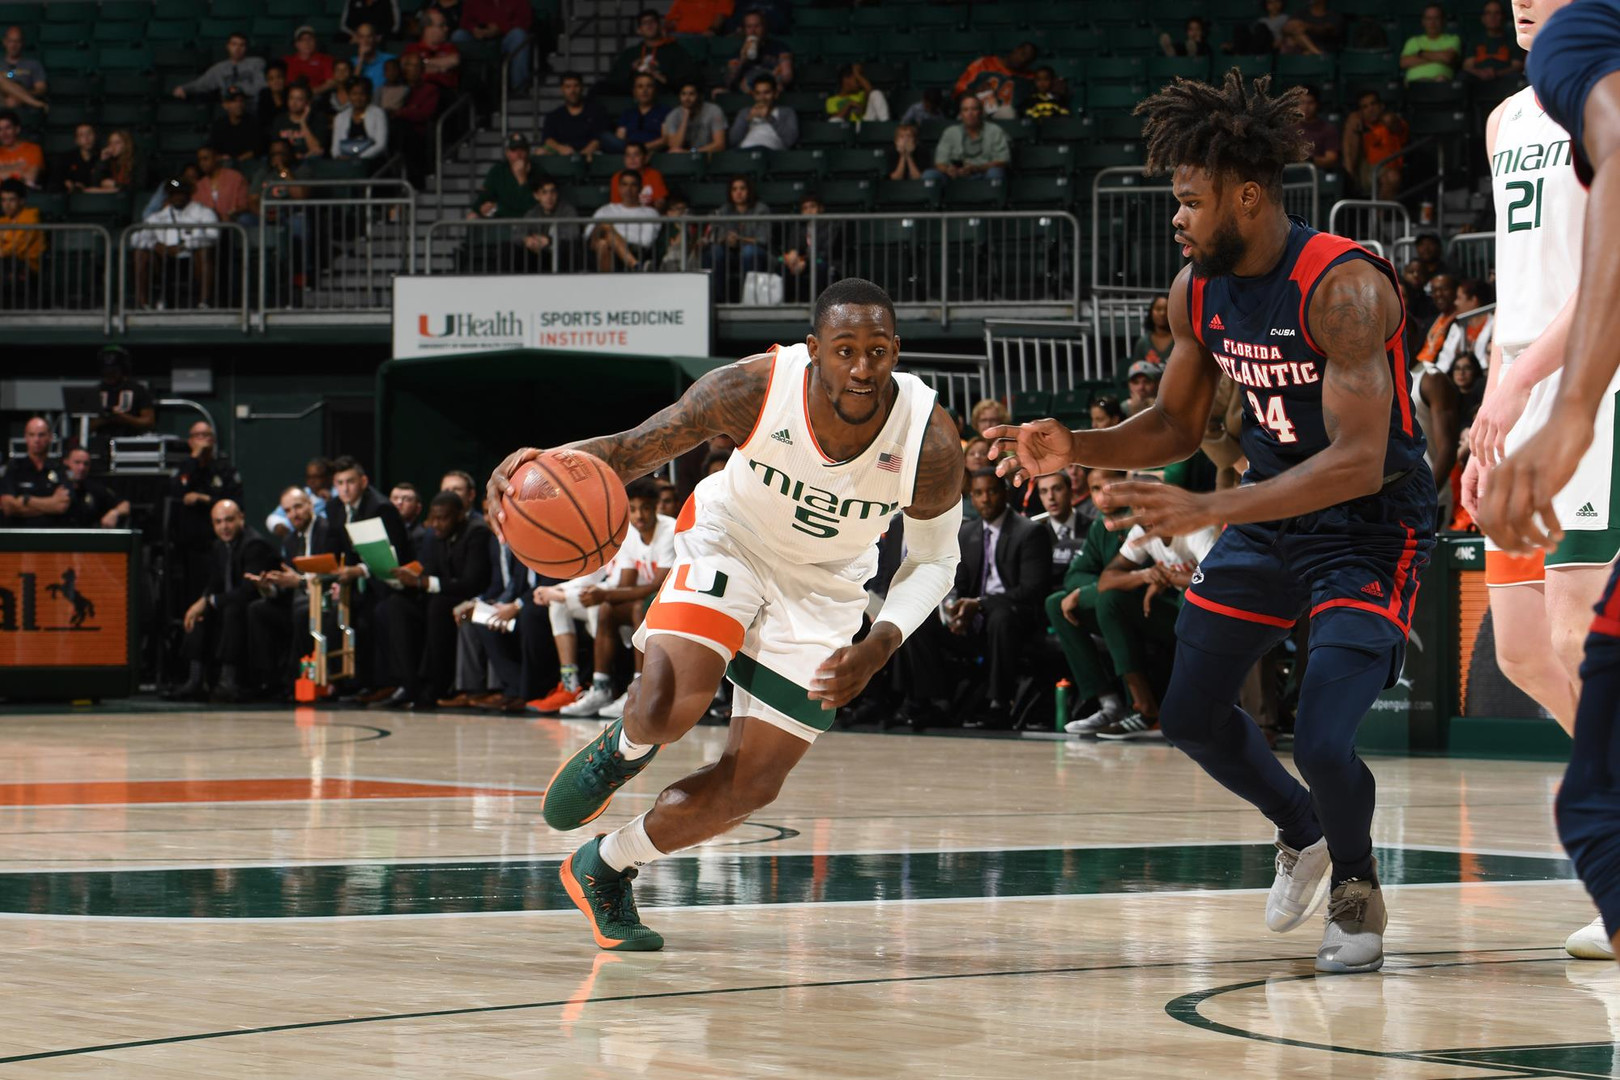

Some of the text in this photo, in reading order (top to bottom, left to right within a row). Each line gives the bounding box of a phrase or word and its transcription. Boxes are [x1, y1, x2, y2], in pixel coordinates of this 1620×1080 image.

[1492, 139, 1572, 177] miam
[1505, 177, 1545, 233] 21
[540, 309, 685, 328] SPORTS MEDICINE
[539, 330, 628, 346] INSTITUTE
[1222, 338, 1282, 360] FLORIDA
[770, 433, 794, 446] adidas
[791, 504, 841, 539] 5
[1575, 510, 1599, 518] adidas
[1360, 585, 1385, 598] adidas
